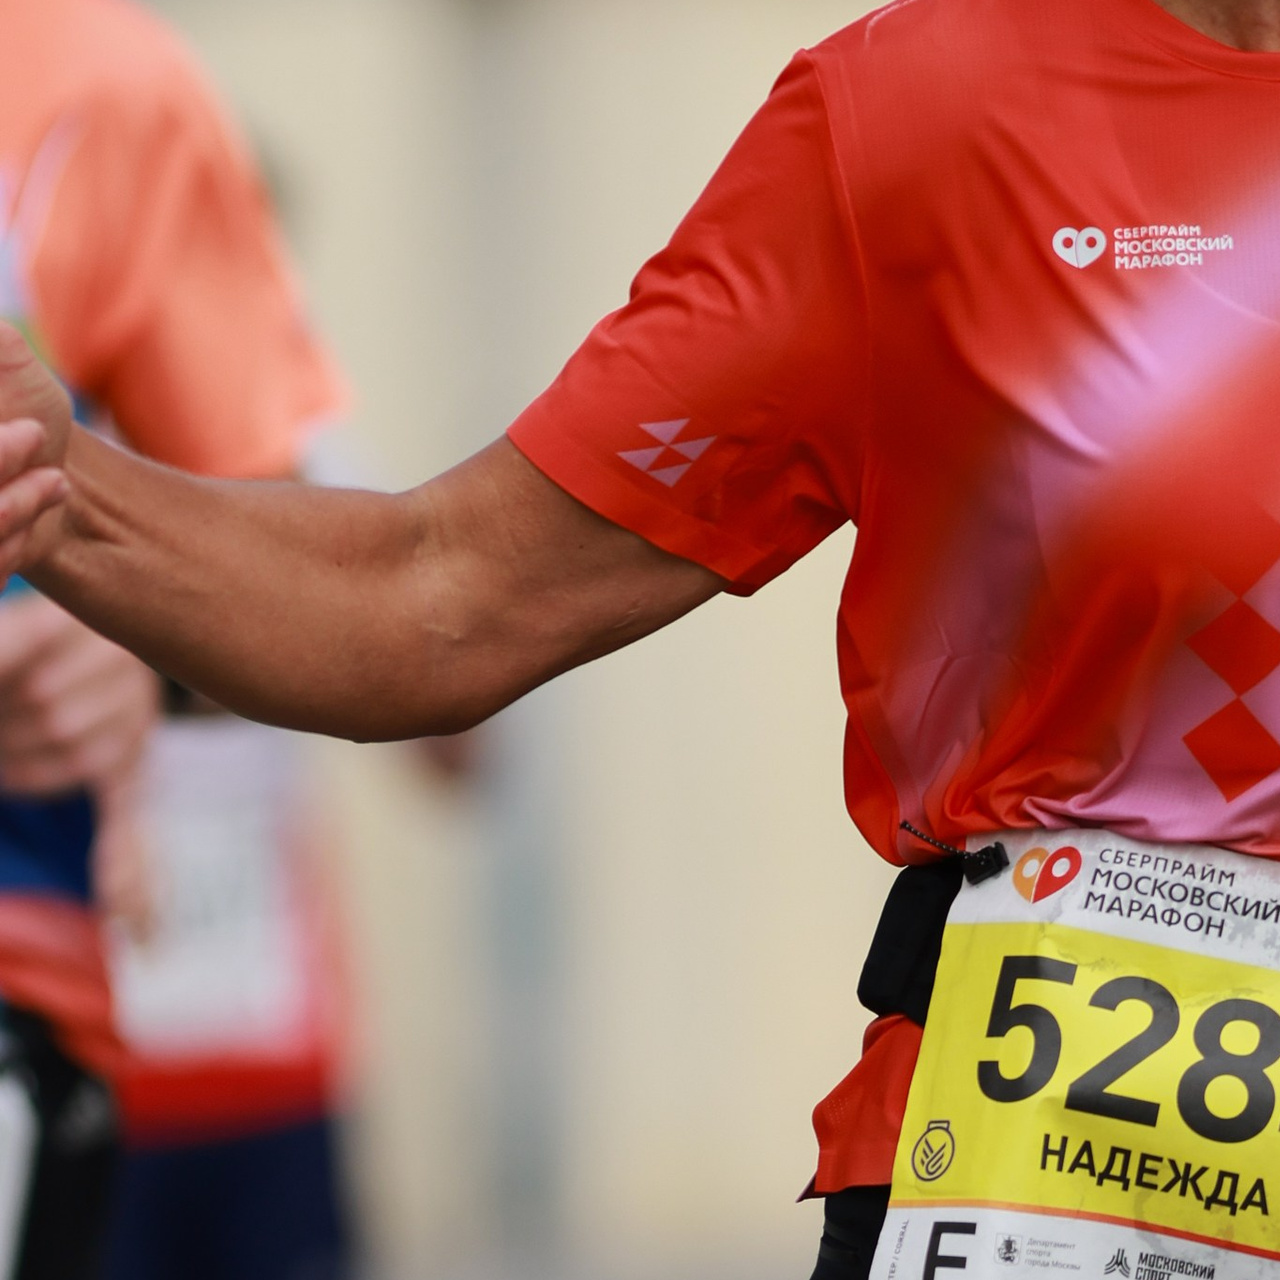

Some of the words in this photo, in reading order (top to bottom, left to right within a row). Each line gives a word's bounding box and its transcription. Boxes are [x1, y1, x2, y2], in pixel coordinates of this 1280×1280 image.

[1113, 224, 1201, 239] СБЕРПРАЙМ
[1114, 235, 1234, 254] МОСКОВСКИЙ
[1115, 253, 1203, 270] МАРАФОН
[1099, 848, 1236, 887] СБЕРПРАЙМ
[1084, 891, 1225, 938] МАРАФОН
[1040, 1133, 1270, 1217] НАДЕЖДА
[1138, 1252, 1215, 1280] МОСКОВСКИЙ
